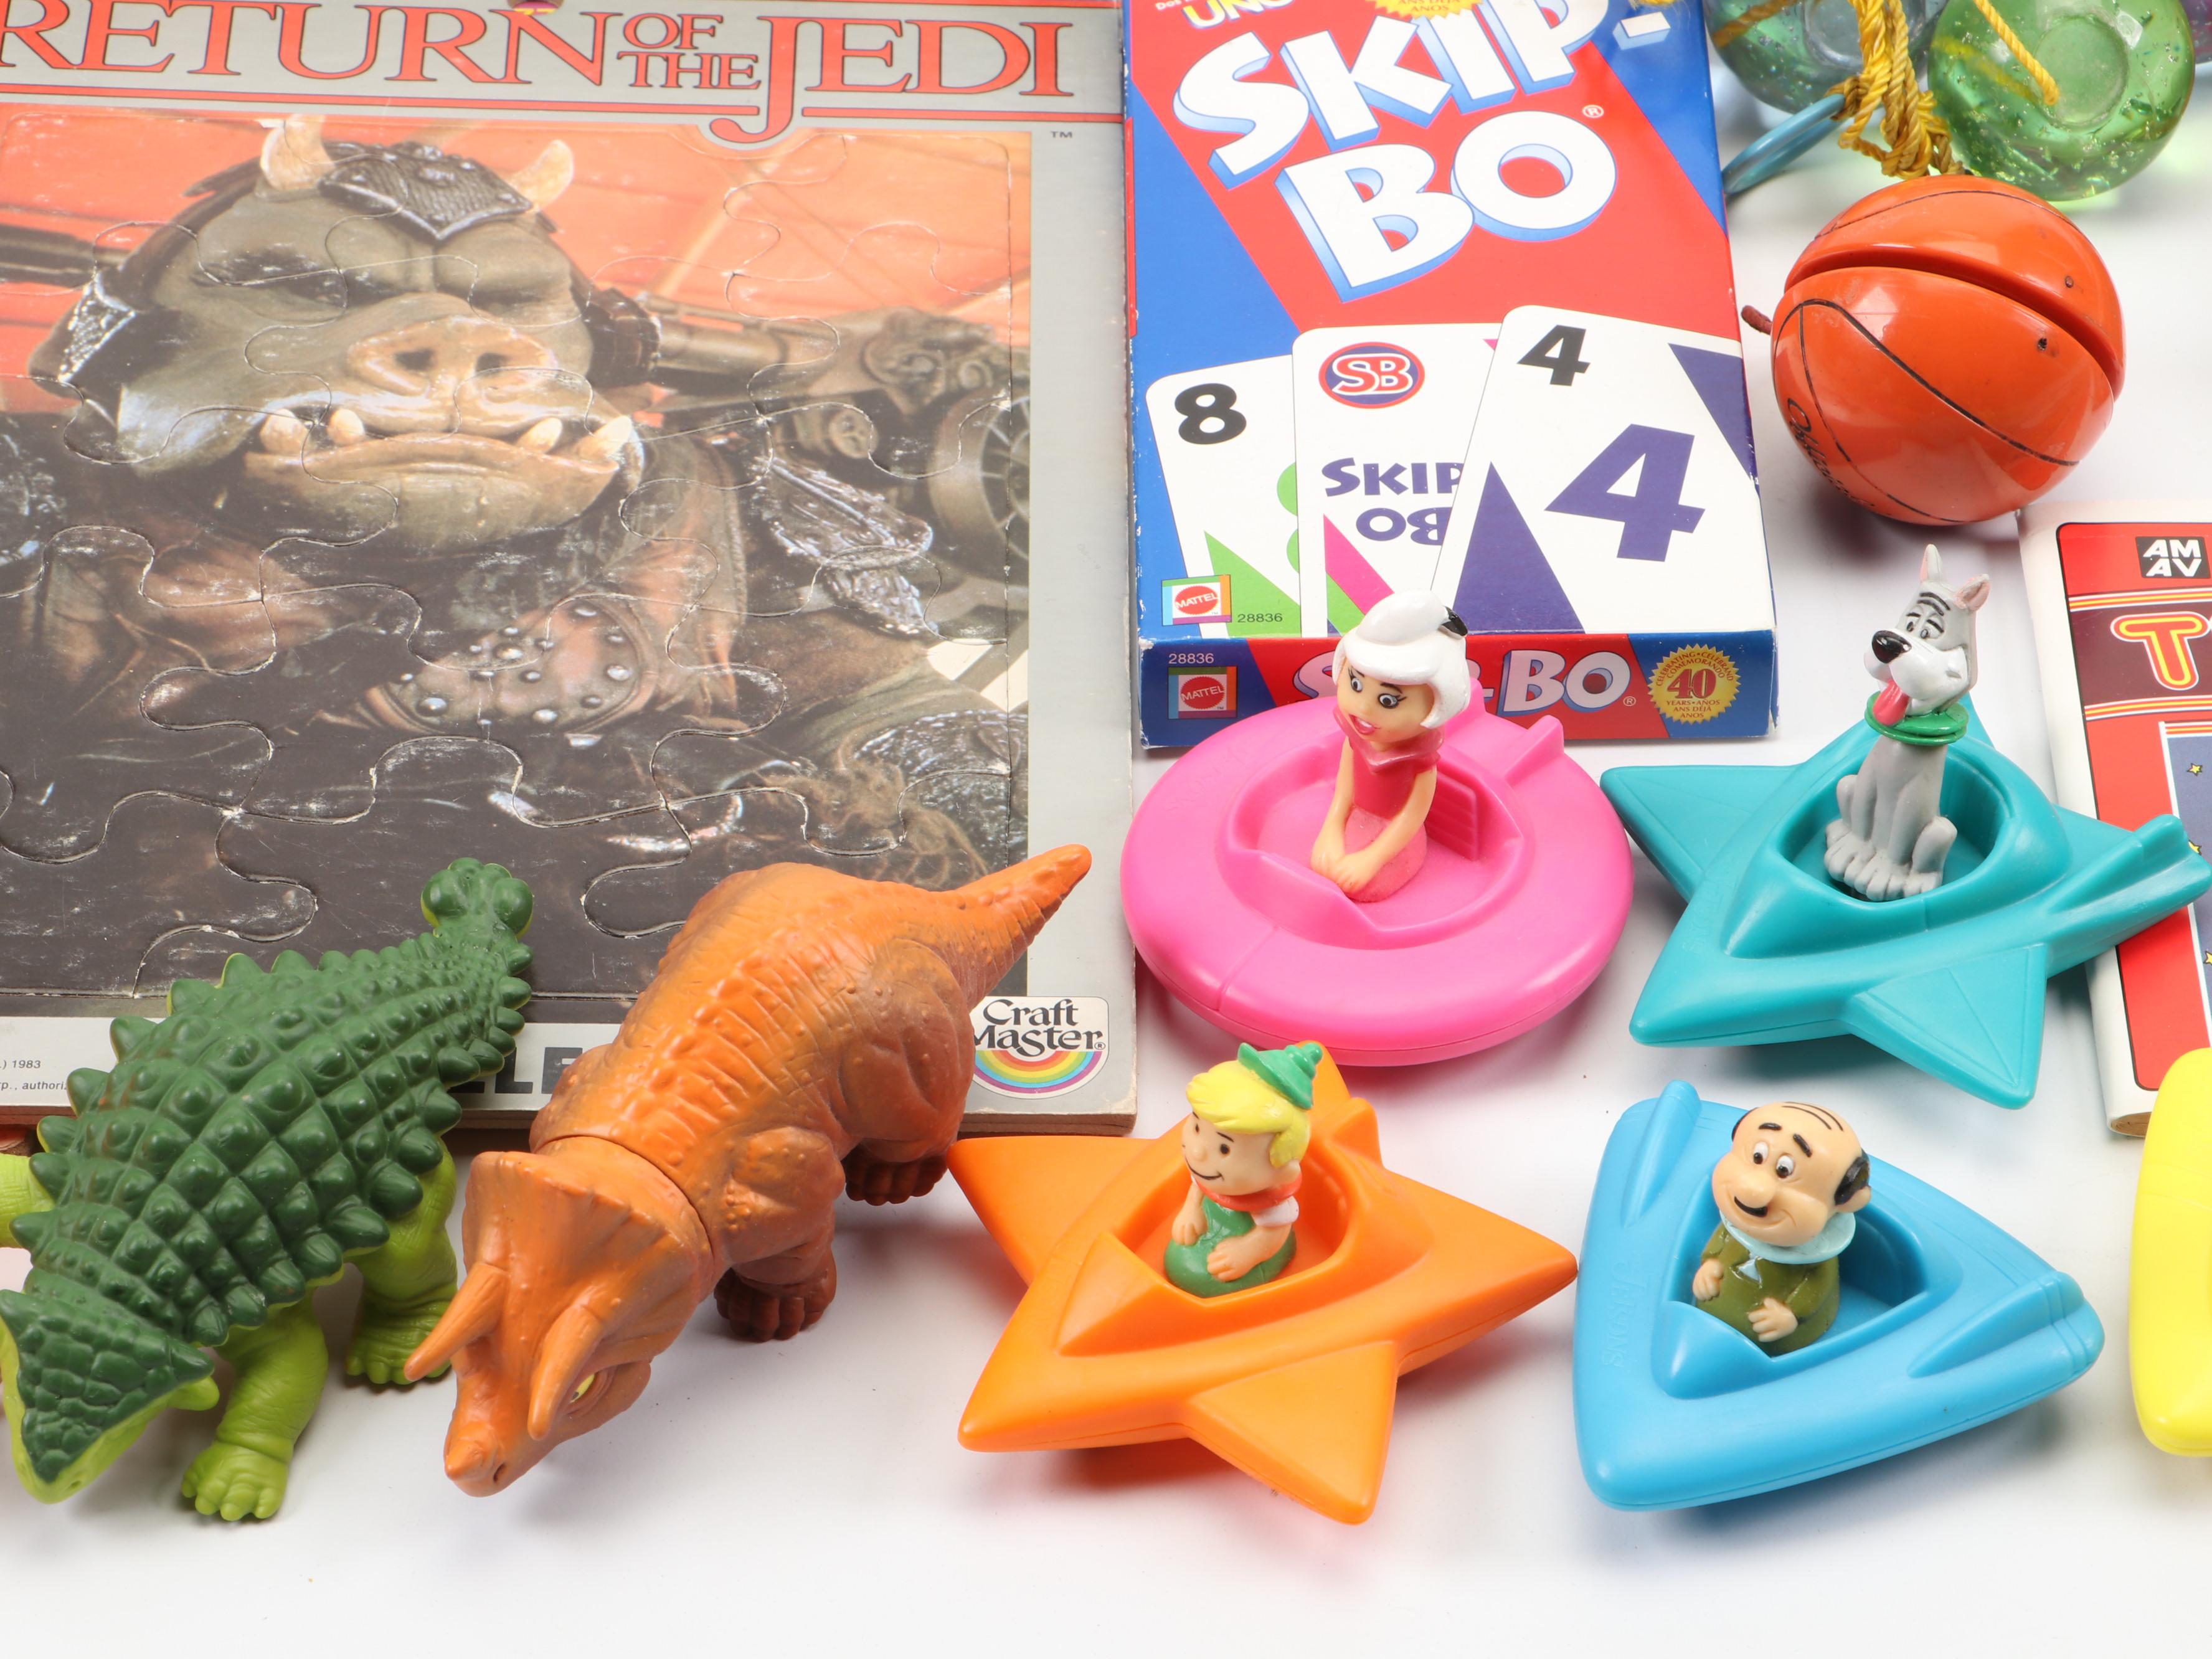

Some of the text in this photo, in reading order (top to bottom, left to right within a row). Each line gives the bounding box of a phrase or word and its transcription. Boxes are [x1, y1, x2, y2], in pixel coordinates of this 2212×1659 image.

[623, 12, 724, 49] OF
[1181, 0, 1296, 29] UN
[0, 0, 623, 85] RETURN
[617, 51, 762, 89] THE
[709, 16, 1074, 143] JEDI
[1050, 130, 1072, 138] TM
[1274, 110, 1617, 303] BO
[1518, 324, 1590, 386] 4
[1331, 353, 1414, 395] SB
[1175, 382, 1246, 445] 8
[1321, 457, 1464, 497] SKIP
[1544, 423, 1705, 562] 4
[1175, 592, 1219, 608] MATTEL
[1237, 613, 1283, 623] 28836
[1168, 653, 1214, 664] 28836
[1656, 651, 1696, 686] CELEBRATING
[1666, 658, 1726, 679] COMEMORANDO
[1182, 686, 1225, 701] MATTEL
[1666, 668, 1716, 699] 40
[983, 999, 1079, 1026] Craft
[974, 1024, 1103, 1057] Master
[12, 1059, 41, 1069] 1983
